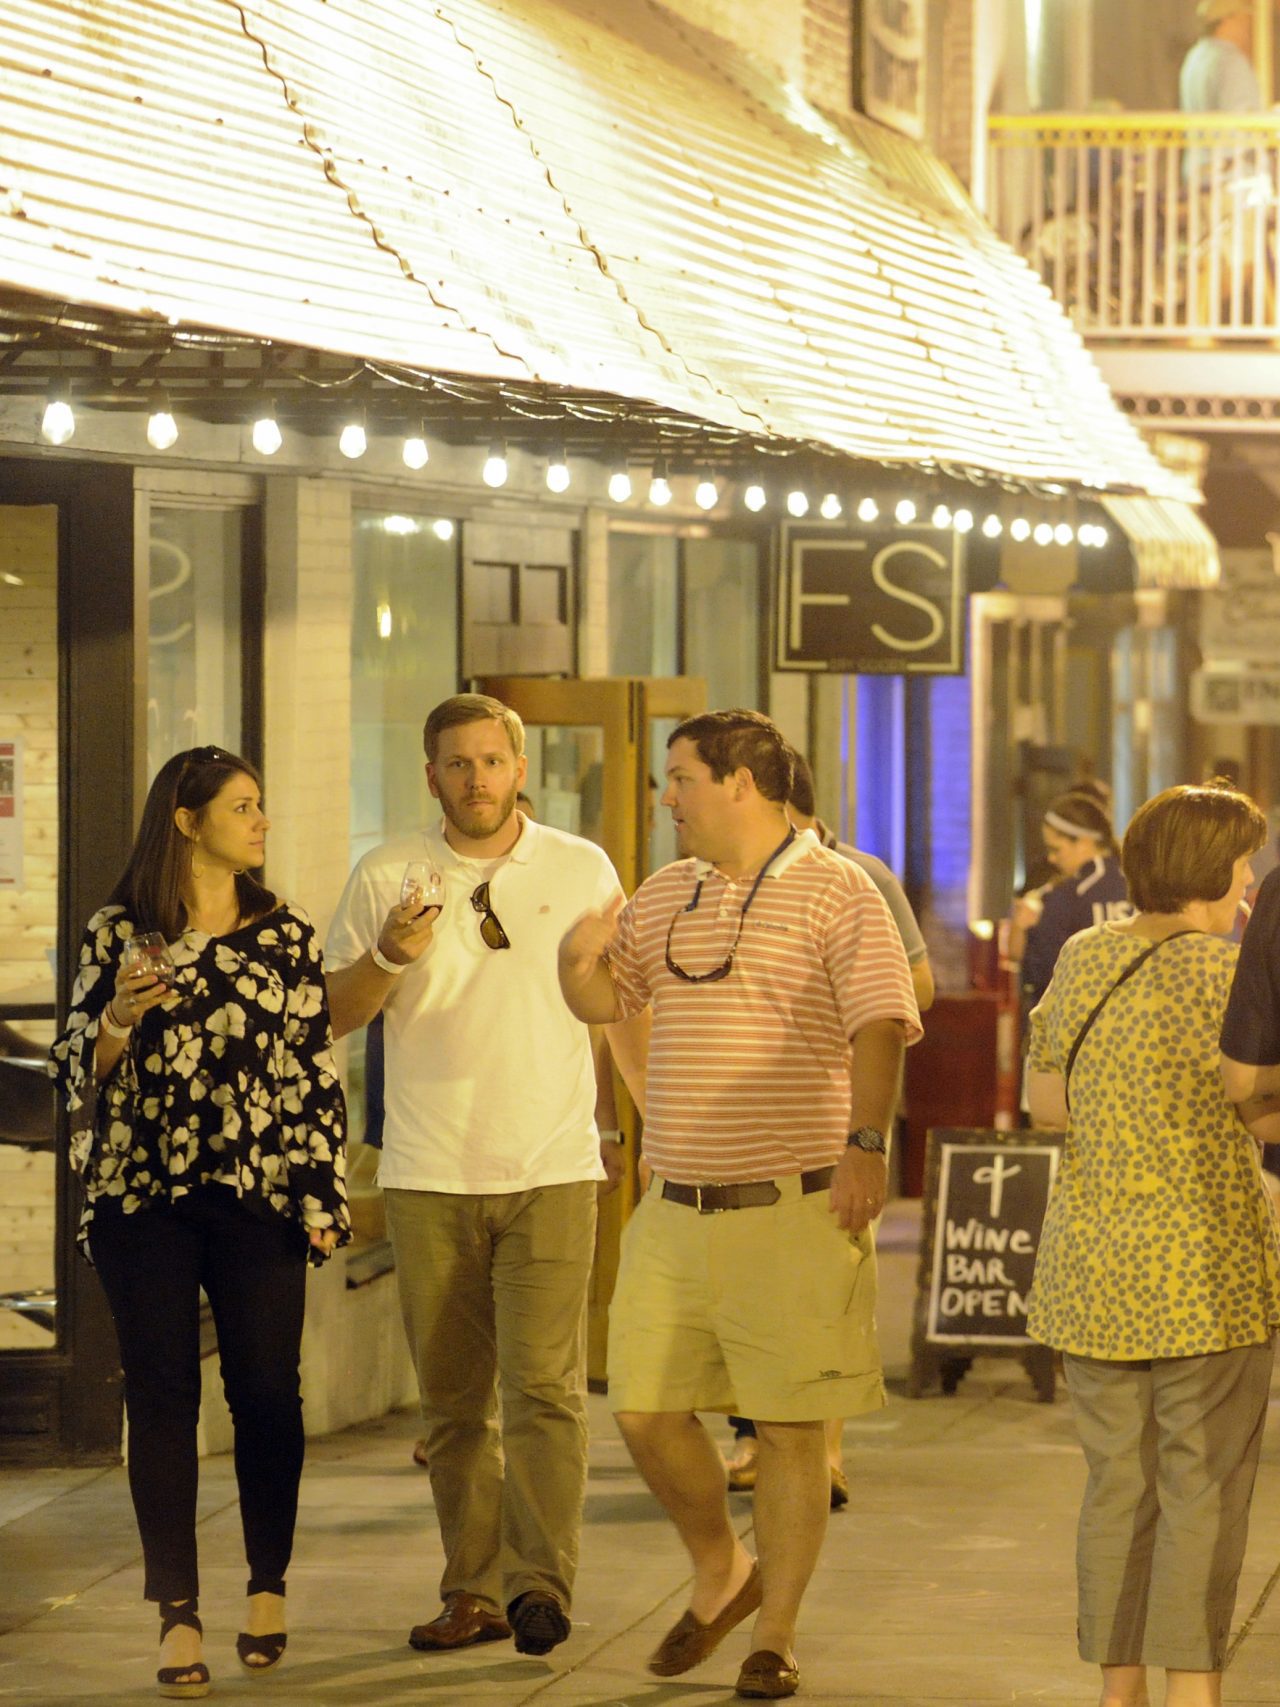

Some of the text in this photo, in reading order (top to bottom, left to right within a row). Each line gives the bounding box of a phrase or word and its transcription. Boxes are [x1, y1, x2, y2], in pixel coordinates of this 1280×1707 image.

[789, 538, 949, 652] FS
[946, 1253, 1016, 1287] BAR
[939, 1286, 1029, 1317] OPEN
